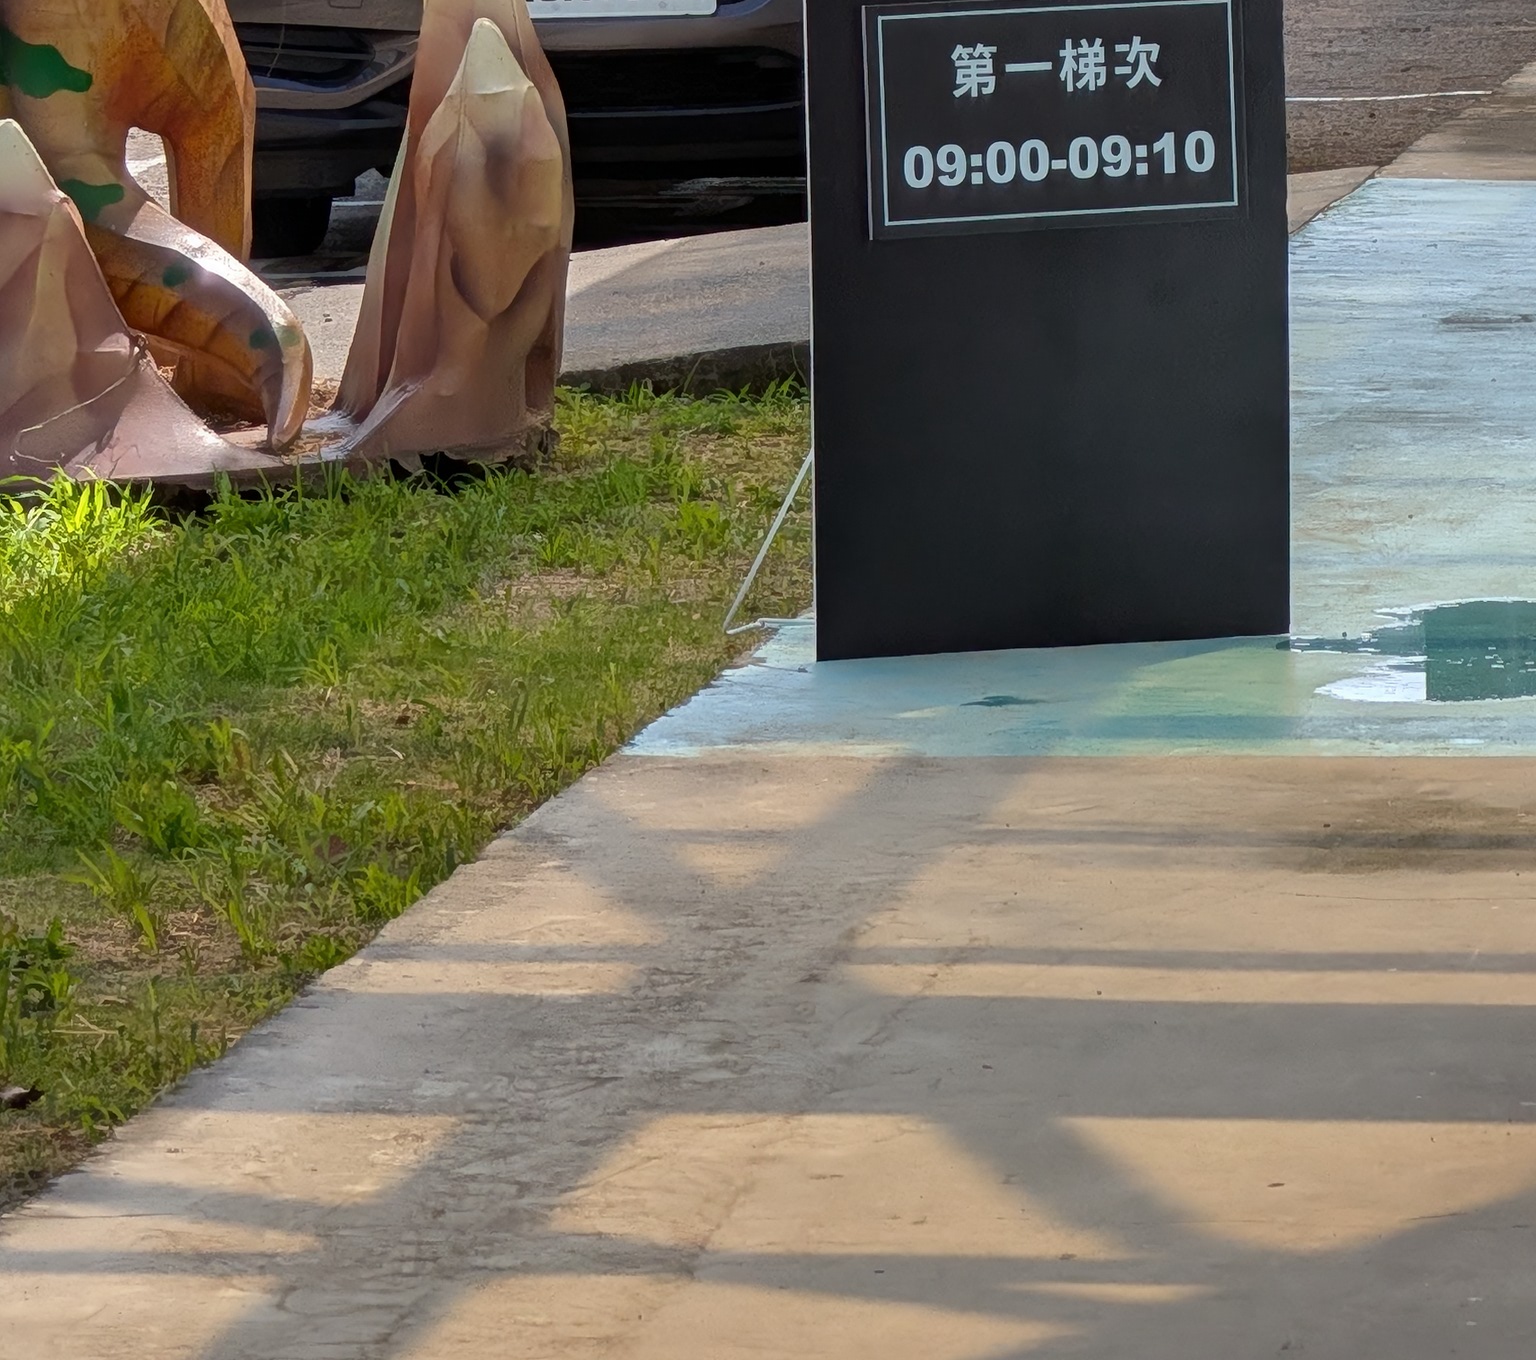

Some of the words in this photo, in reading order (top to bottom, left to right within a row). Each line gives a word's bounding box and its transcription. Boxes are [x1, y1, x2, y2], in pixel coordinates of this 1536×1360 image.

[950, 36, 1163, 98] 第一梯次
[903, 131, 1216, 189] 09:00-09:10
